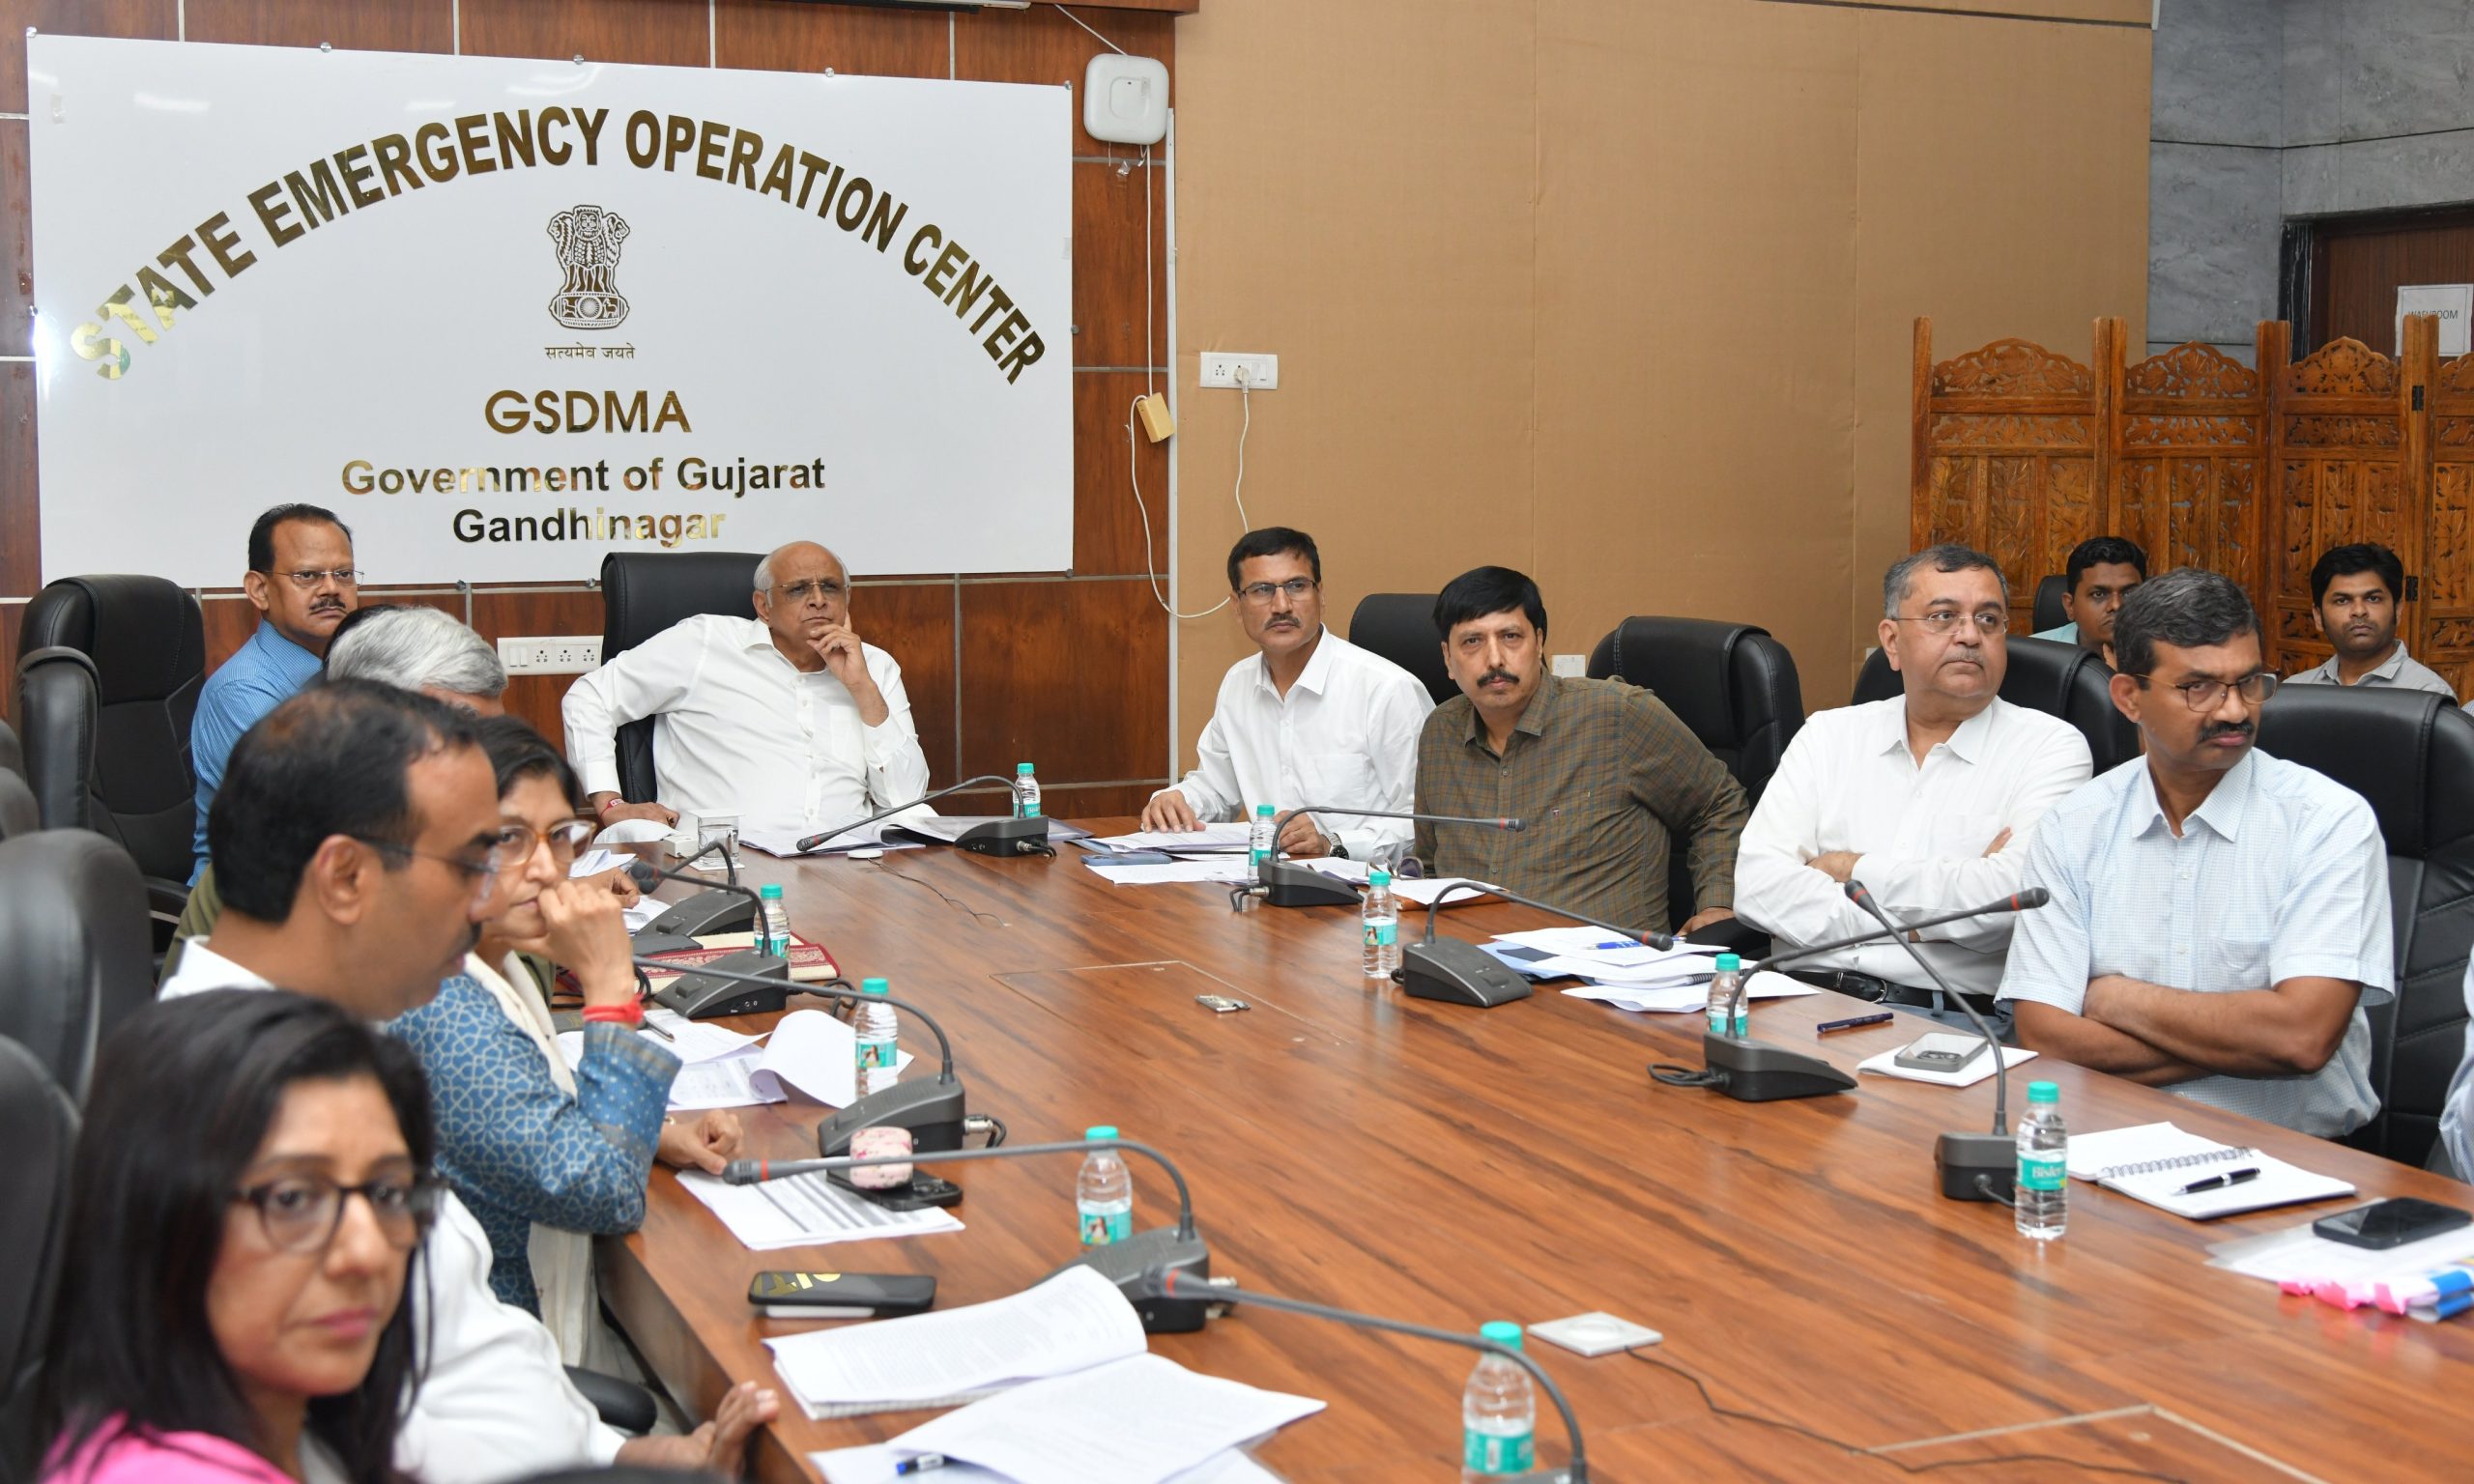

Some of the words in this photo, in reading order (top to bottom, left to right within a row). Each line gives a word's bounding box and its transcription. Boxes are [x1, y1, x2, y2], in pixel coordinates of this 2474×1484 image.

[71, 211, 258, 380] STATE
[246, 106, 610, 248] EMERGENCY
[626, 110, 909, 254] OPERATION
[905, 224, 1046, 385] CENTER
[544, 342, 596, 359] सत्यमेव
[601, 342, 636, 359] जयते
[484, 389, 692, 435] GSDMA
[341, 459, 610, 496] Government
[623, 457, 664, 492] of
[676, 457, 825, 499] Gujarat
[453, 507, 726, 549] Gandhinagar
